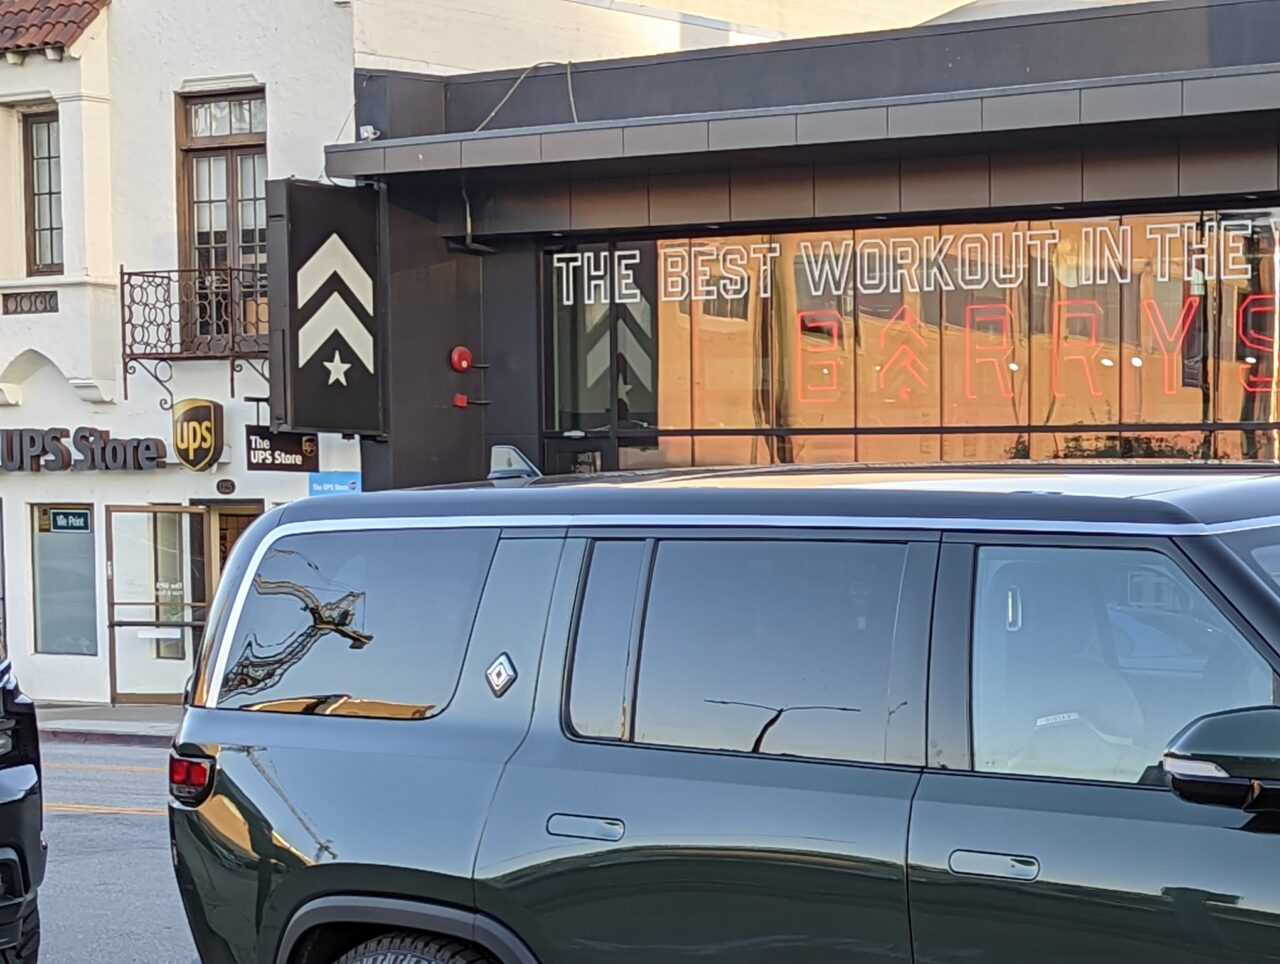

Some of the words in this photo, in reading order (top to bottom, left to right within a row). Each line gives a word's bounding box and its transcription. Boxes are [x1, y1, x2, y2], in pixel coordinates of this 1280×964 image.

[552, 249, 642, 306] THE
[659, 242, 780, 302] BEST
[800, 227, 1060, 297] WORKOUT
[1080, 223, 1134, 286] IN
[1145, 218, 1253, 283] THE
[0, 428, 71, 472] UPS
[72, 427, 166, 472] Store
[176, 420, 213, 461] ups
[251, 435, 271, 450] The
[250, 451, 273, 464] UPS
[274, 450, 303, 465] Store
[56, 515, 68, 527] We
[68, 516, 85, 527] Print
